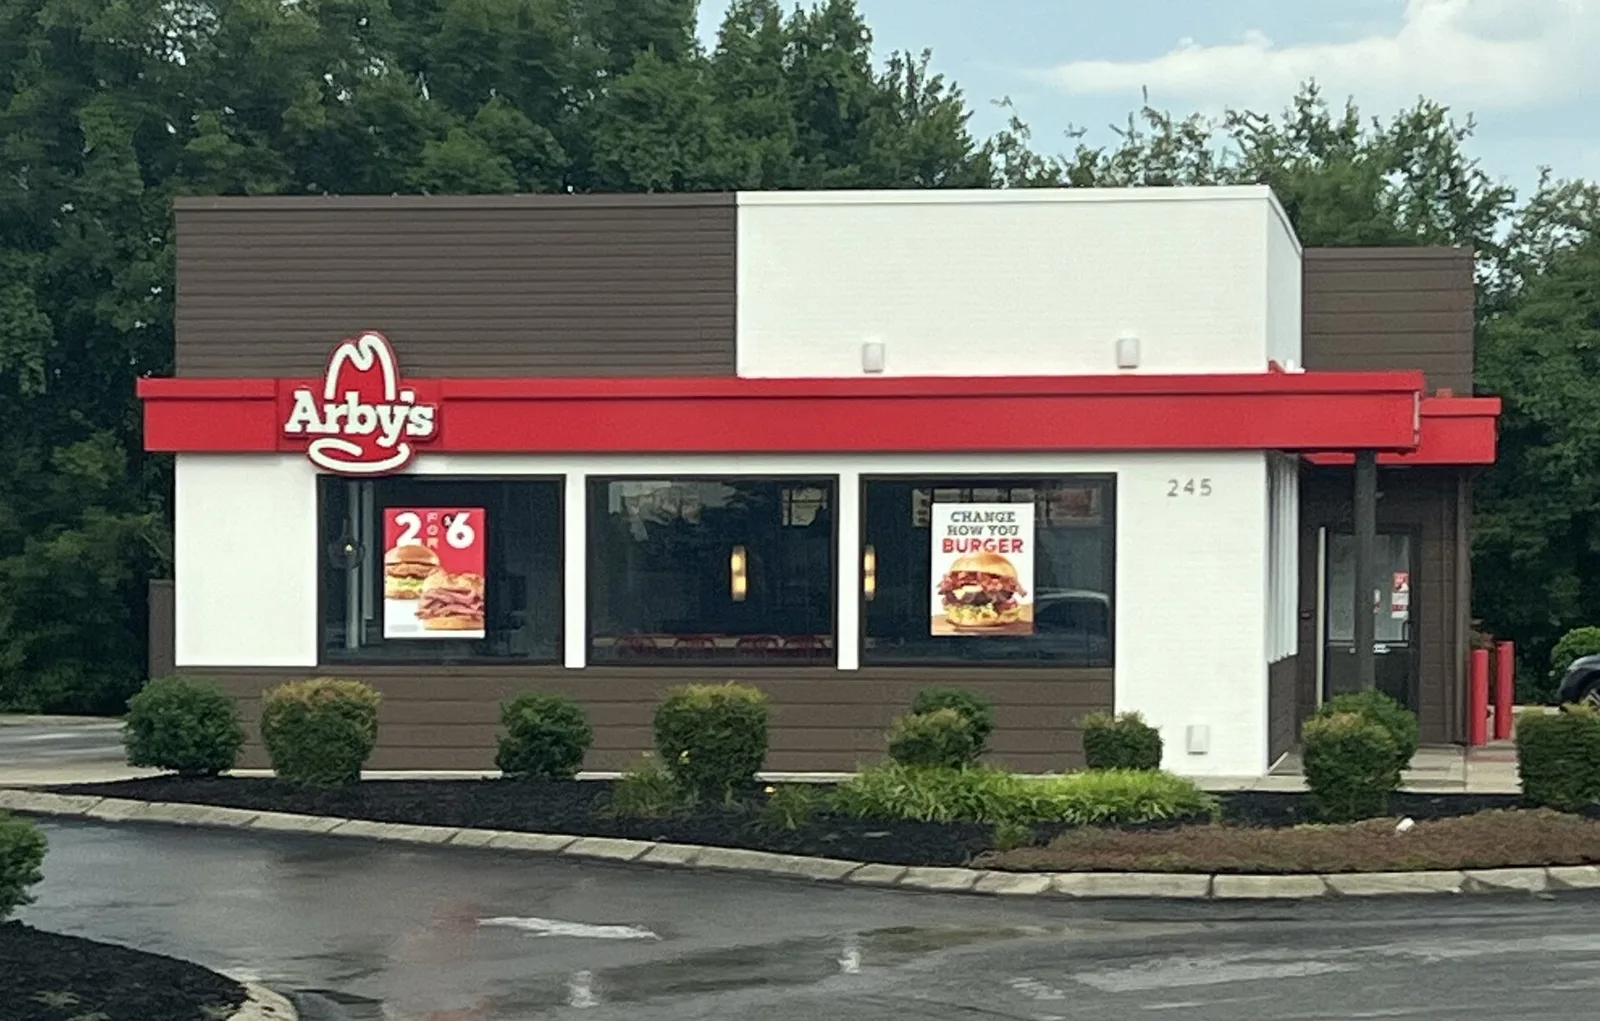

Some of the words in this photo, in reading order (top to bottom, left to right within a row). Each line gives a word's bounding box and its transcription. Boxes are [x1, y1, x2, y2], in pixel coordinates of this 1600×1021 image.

[284, 389, 435, 448] Arby's
[1166, 478, 1213, 498] 245
[950, 511, 1016, 523] CHANGE
[395, 511, 422, 548] 2
[426, 512, 440, 549] FOR
[947, 525, 984, 536] HOW
[987, 525, 1020, 536] YOU
[942, 538, 1024, 553] BURGER
